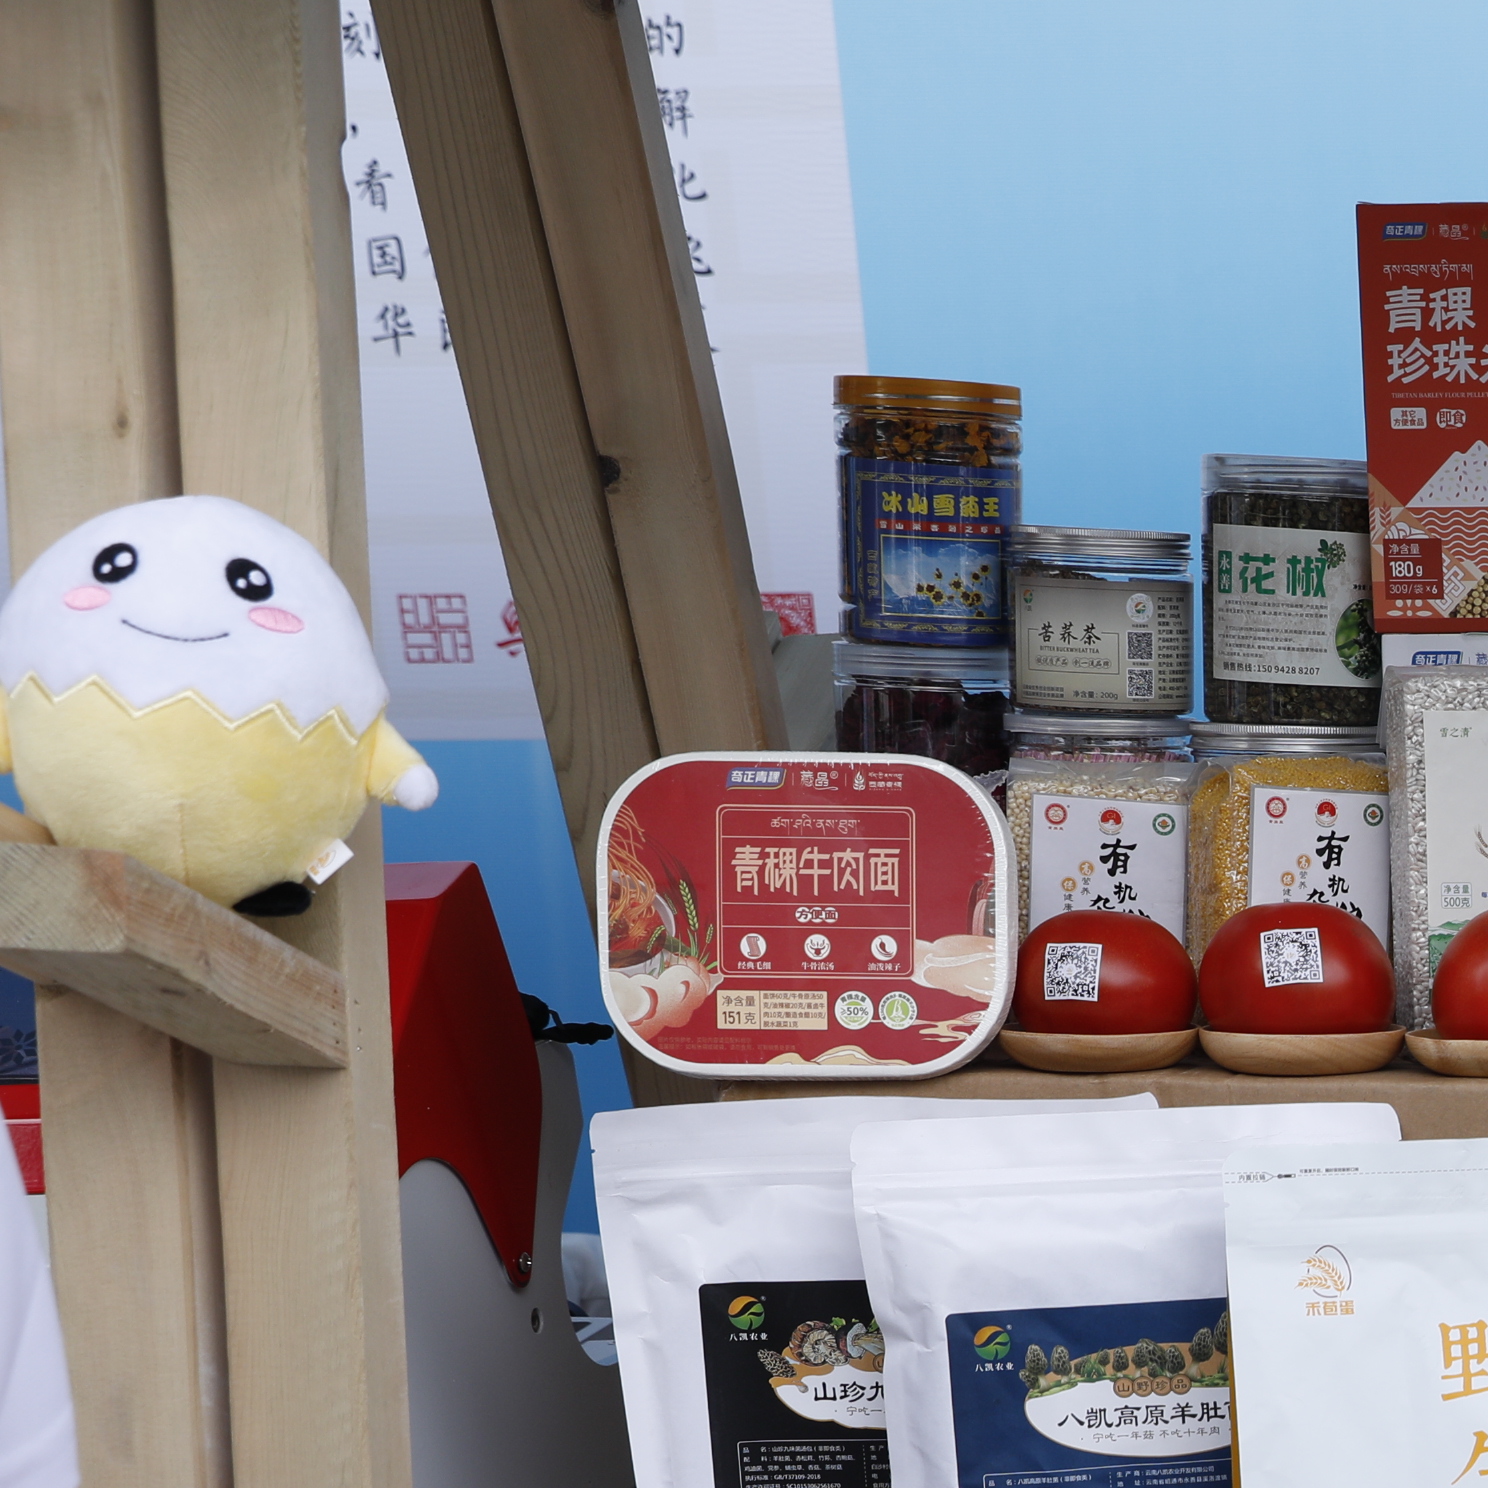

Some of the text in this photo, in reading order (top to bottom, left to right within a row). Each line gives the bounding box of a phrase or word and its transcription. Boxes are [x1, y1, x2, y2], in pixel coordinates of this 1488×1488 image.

[1385, 224, 1424, 236] 奇正青稞
[369, 235, 407, 280] 国
[1384, 285, 1476, 333] 青稞
[372, 303, 415, 354] 华
[1439, 410, 1465, 425] 即食
[881, 491, 1000, 518] 冰山雪菊王
[1389, 542, 1420, 556] 净含量
[1219, 554, 1231, 590] 永善
[1238, 552, 1327, 597] 花椒
[1038, 621, 1101, 645] 苦荞茶
[730, 770, 780, 783] 奇正青稞
[731, 845, 900, 897] 青稞牛肉面
[1443, 884, 1470, 894] 净含量
[1443, 897, 1470, 908] 500克
[798, 909, 837, 921] 方便面
[722, 995, 756, 1007] 净含量
[722, 1011, 757, 1025] 151克
[1306, 1300, 1355, 1316] 禾苞蛋
[729, 1333, 768, 1341] 八凯农业
[975, 1362, 1015, 1372] 八凯农业
[1117, 1378, 1188, 1392] 山野珍品
[1092, 1426, 1220, 1444] 宁吃一年菇 不吃十年肉
